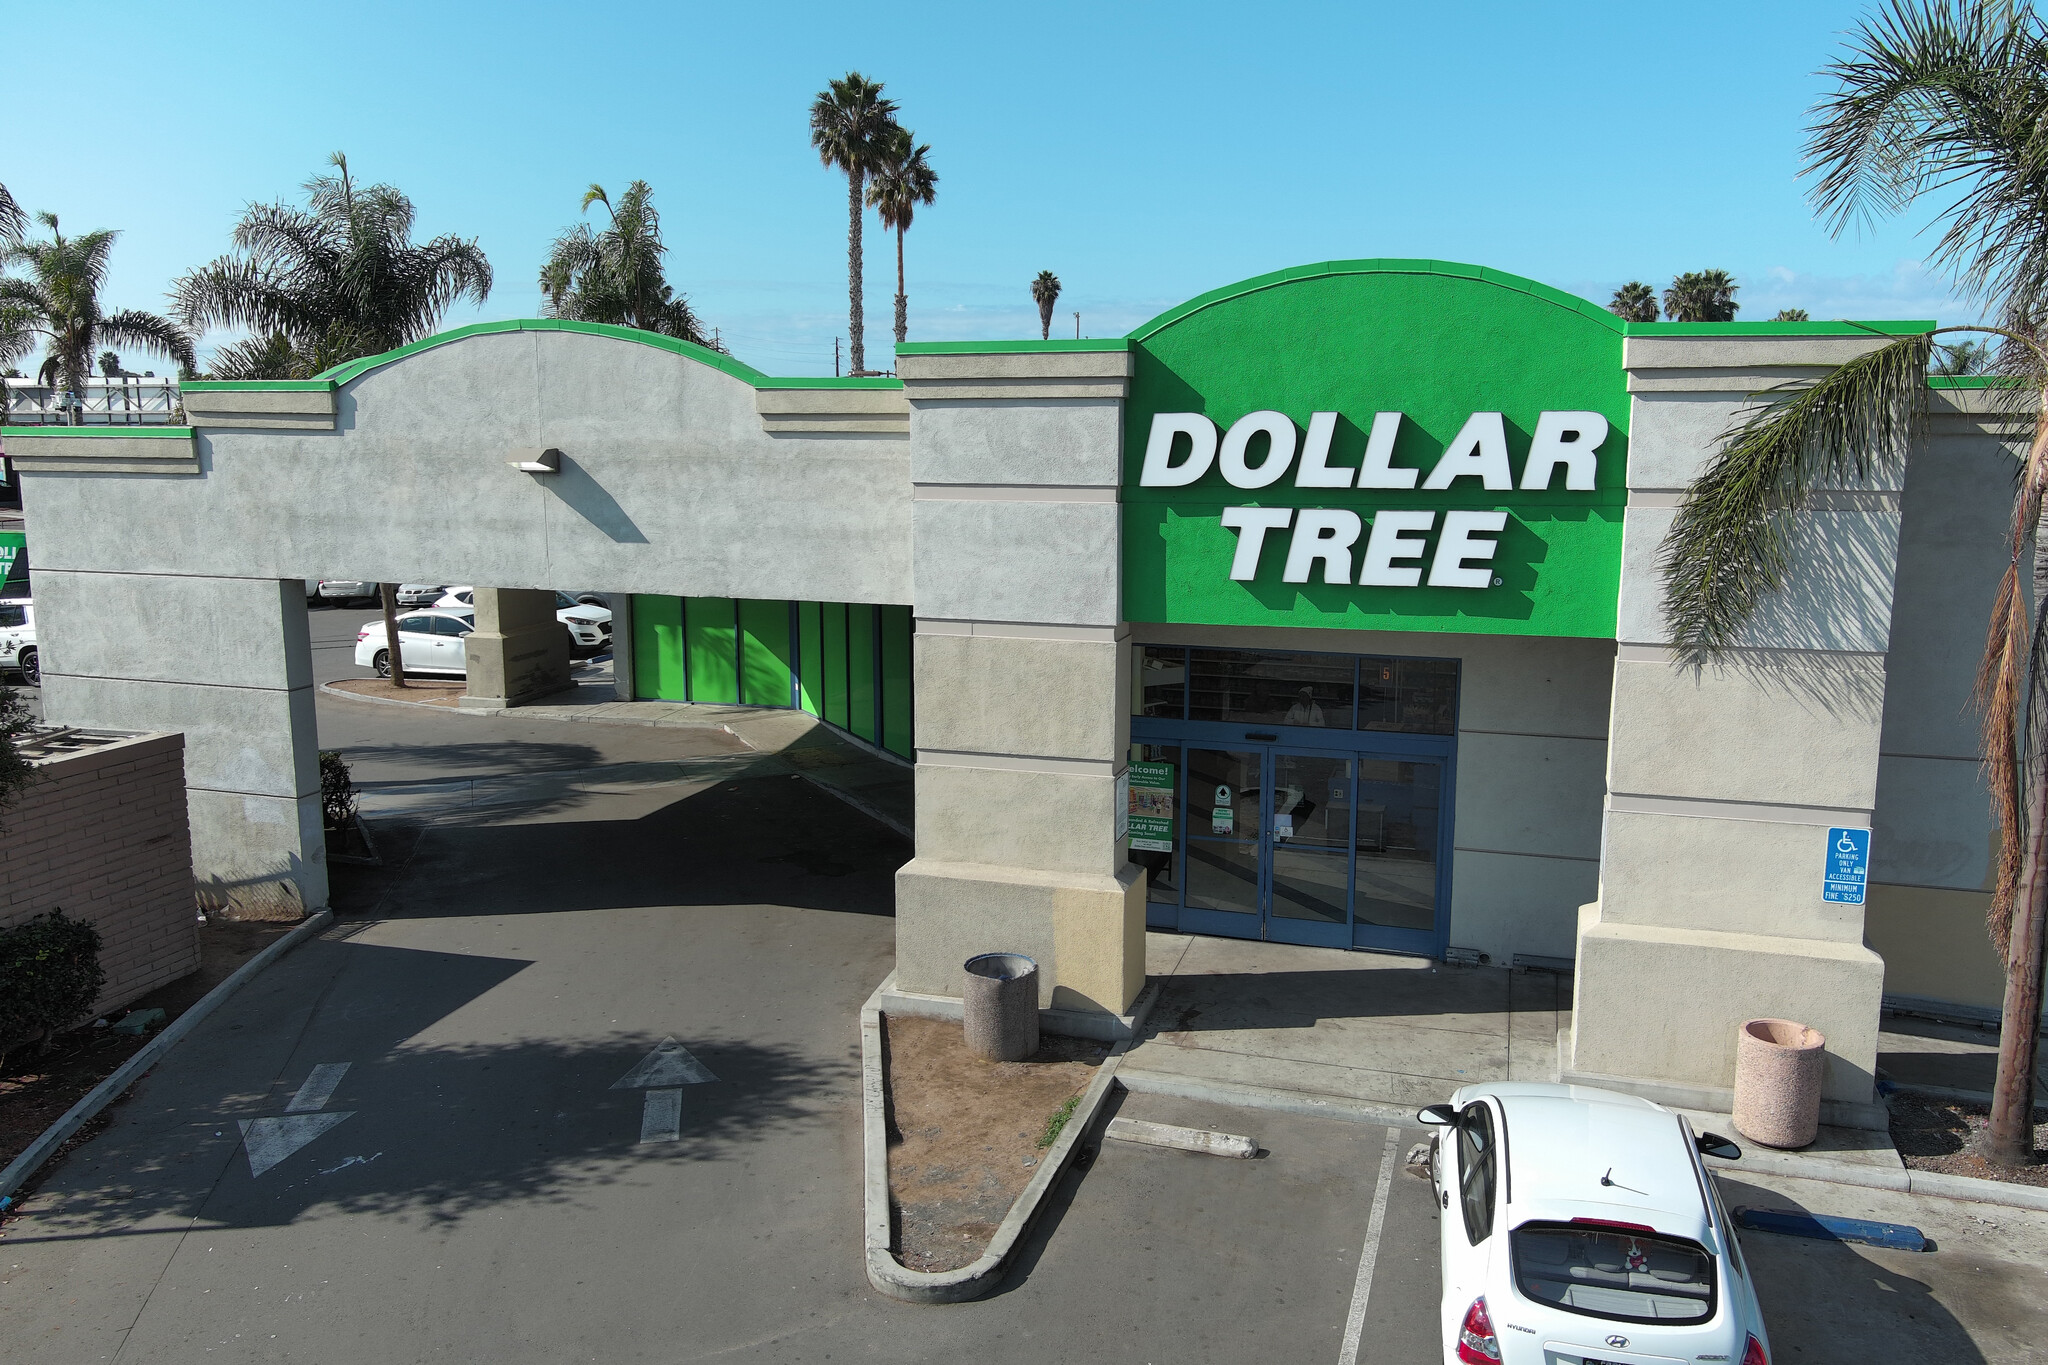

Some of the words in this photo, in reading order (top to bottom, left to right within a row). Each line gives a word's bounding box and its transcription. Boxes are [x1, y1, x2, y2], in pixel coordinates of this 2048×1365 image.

[1139, 410, 1608, 491] DOLLAR
[1220, 506, 1509, 588] TREE
[1129, 764, 1168, 775] elcome!
[1835, 852, 1859, 860] PARKING
[1830, 883, 1858, 892] MINIMUM
[1825, 891, 1839, 900] FINE
[1507, 1323, 1536, 1335] HYUNDAI
